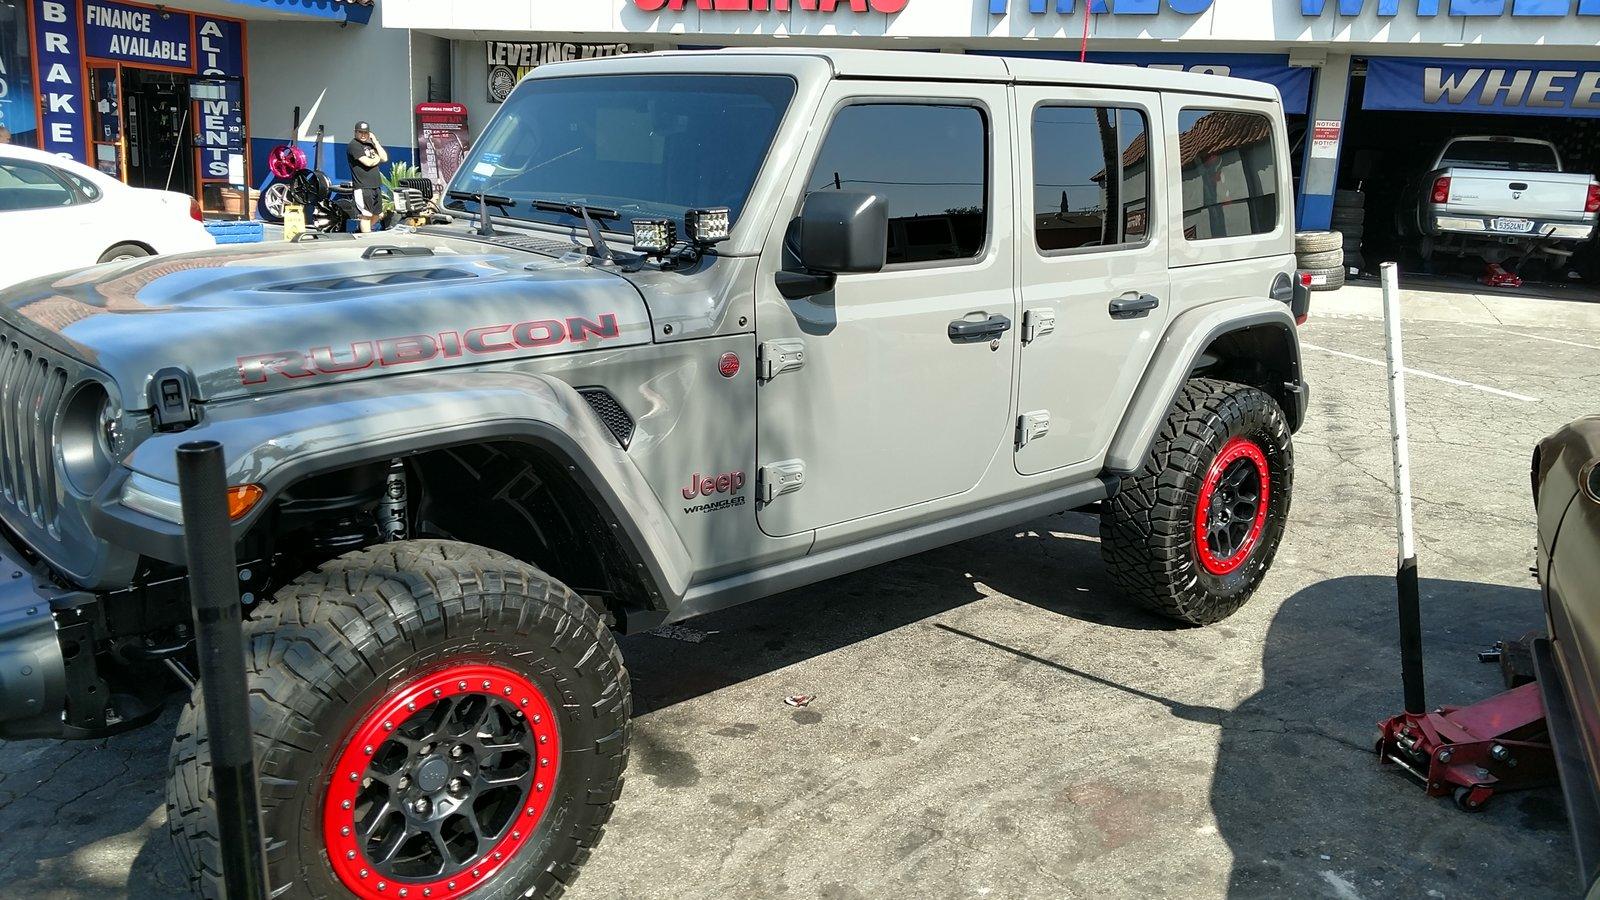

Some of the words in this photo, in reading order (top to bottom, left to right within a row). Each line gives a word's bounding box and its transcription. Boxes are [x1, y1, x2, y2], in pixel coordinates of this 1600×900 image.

[86, 5, 151, 33] FINANCE
[109, 34, 187, 62] AVAILABLE
[487, 41, 577, 65] LEVELING
[200, 21, 229, 177] ALIMENTS
[236, 313, 620, 386] RUBICON
[682, 471, 746, 500] Jeep
[683, 496, 746, 514] WRANGLER
